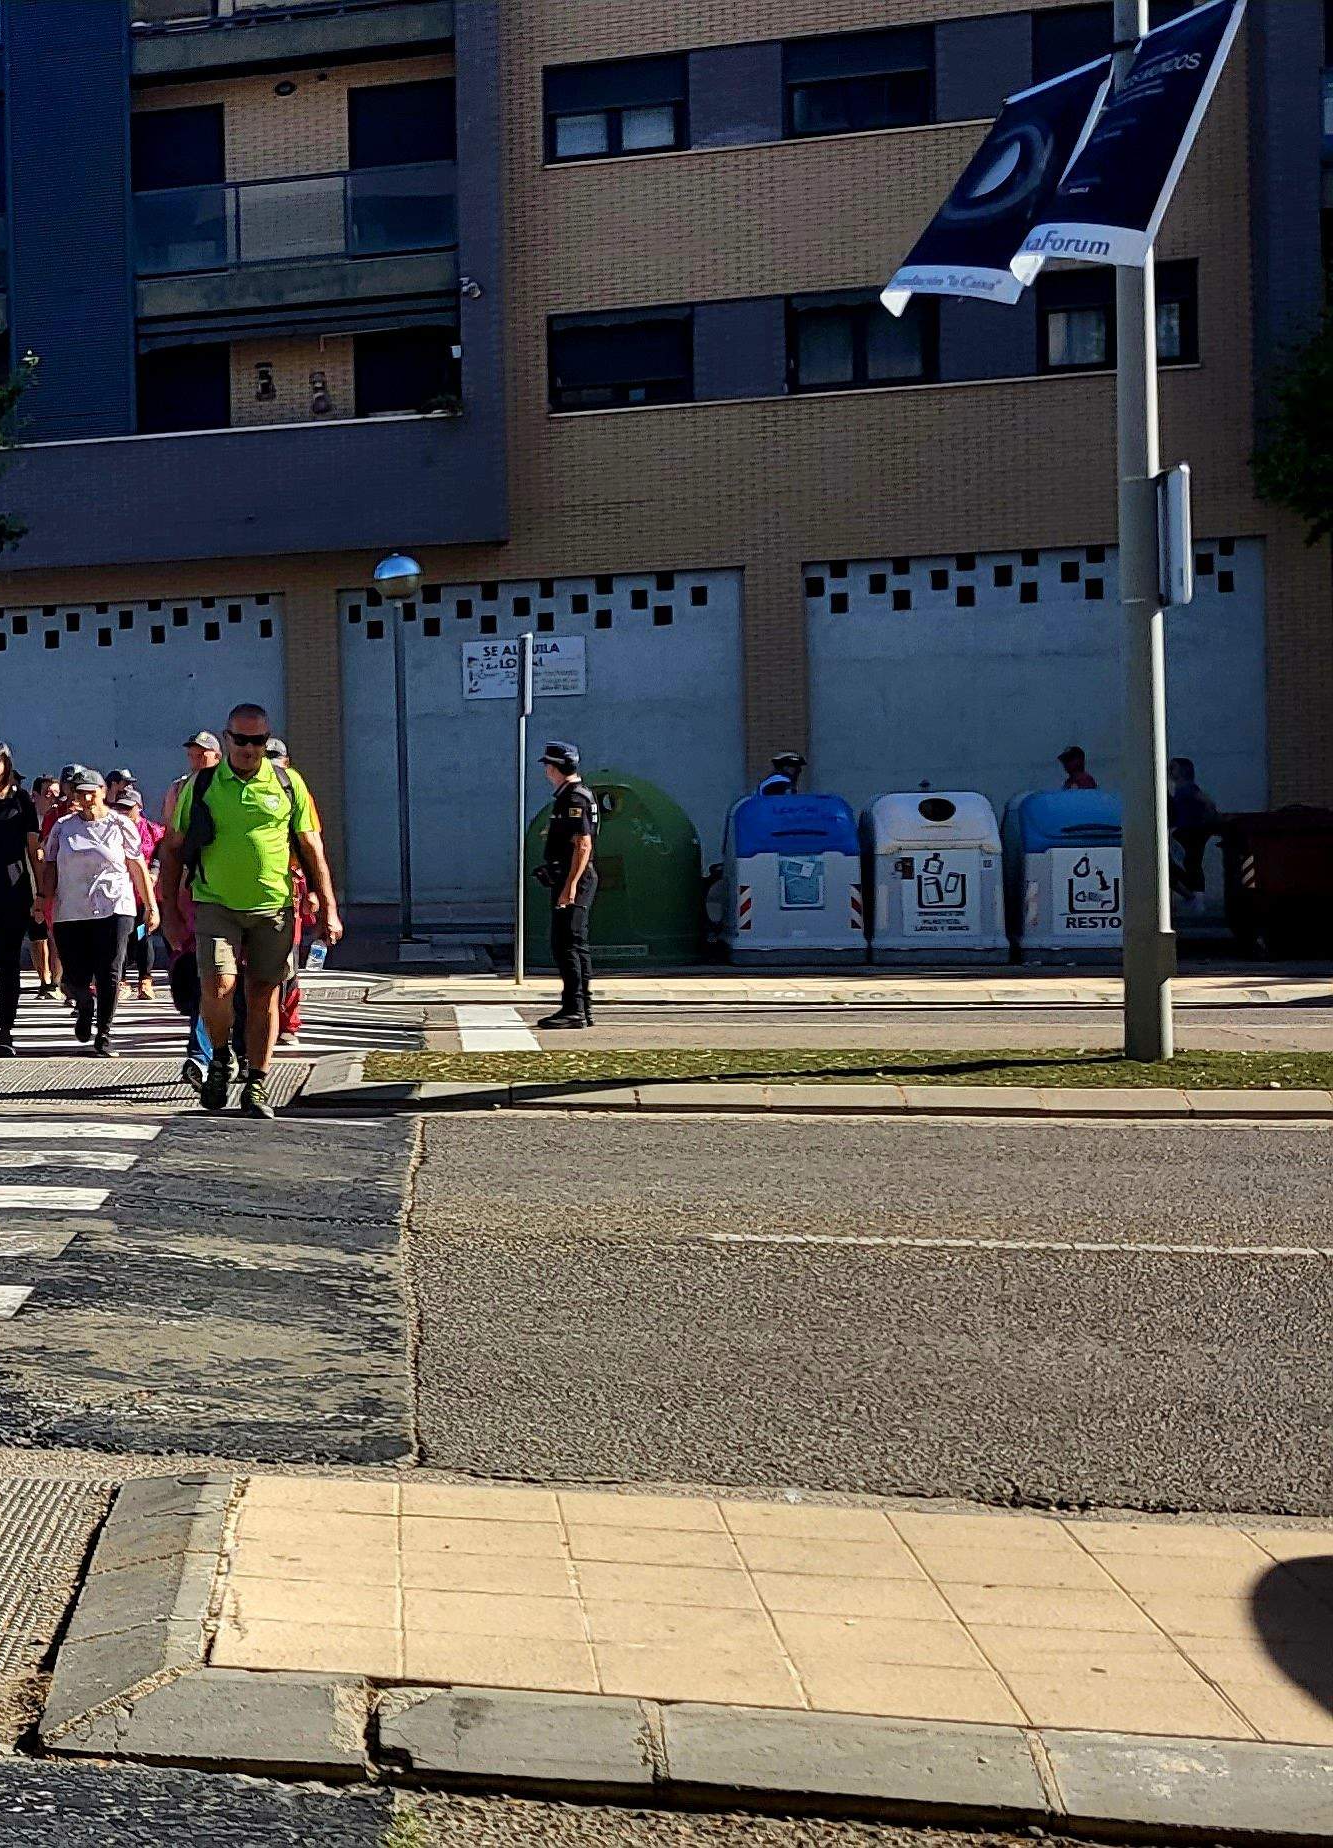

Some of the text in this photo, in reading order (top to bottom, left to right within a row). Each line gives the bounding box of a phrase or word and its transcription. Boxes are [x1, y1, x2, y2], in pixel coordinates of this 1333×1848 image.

[483, 643, 560, 657] SE ALUILA
[1066, 916, 1122, 929] RESTO
